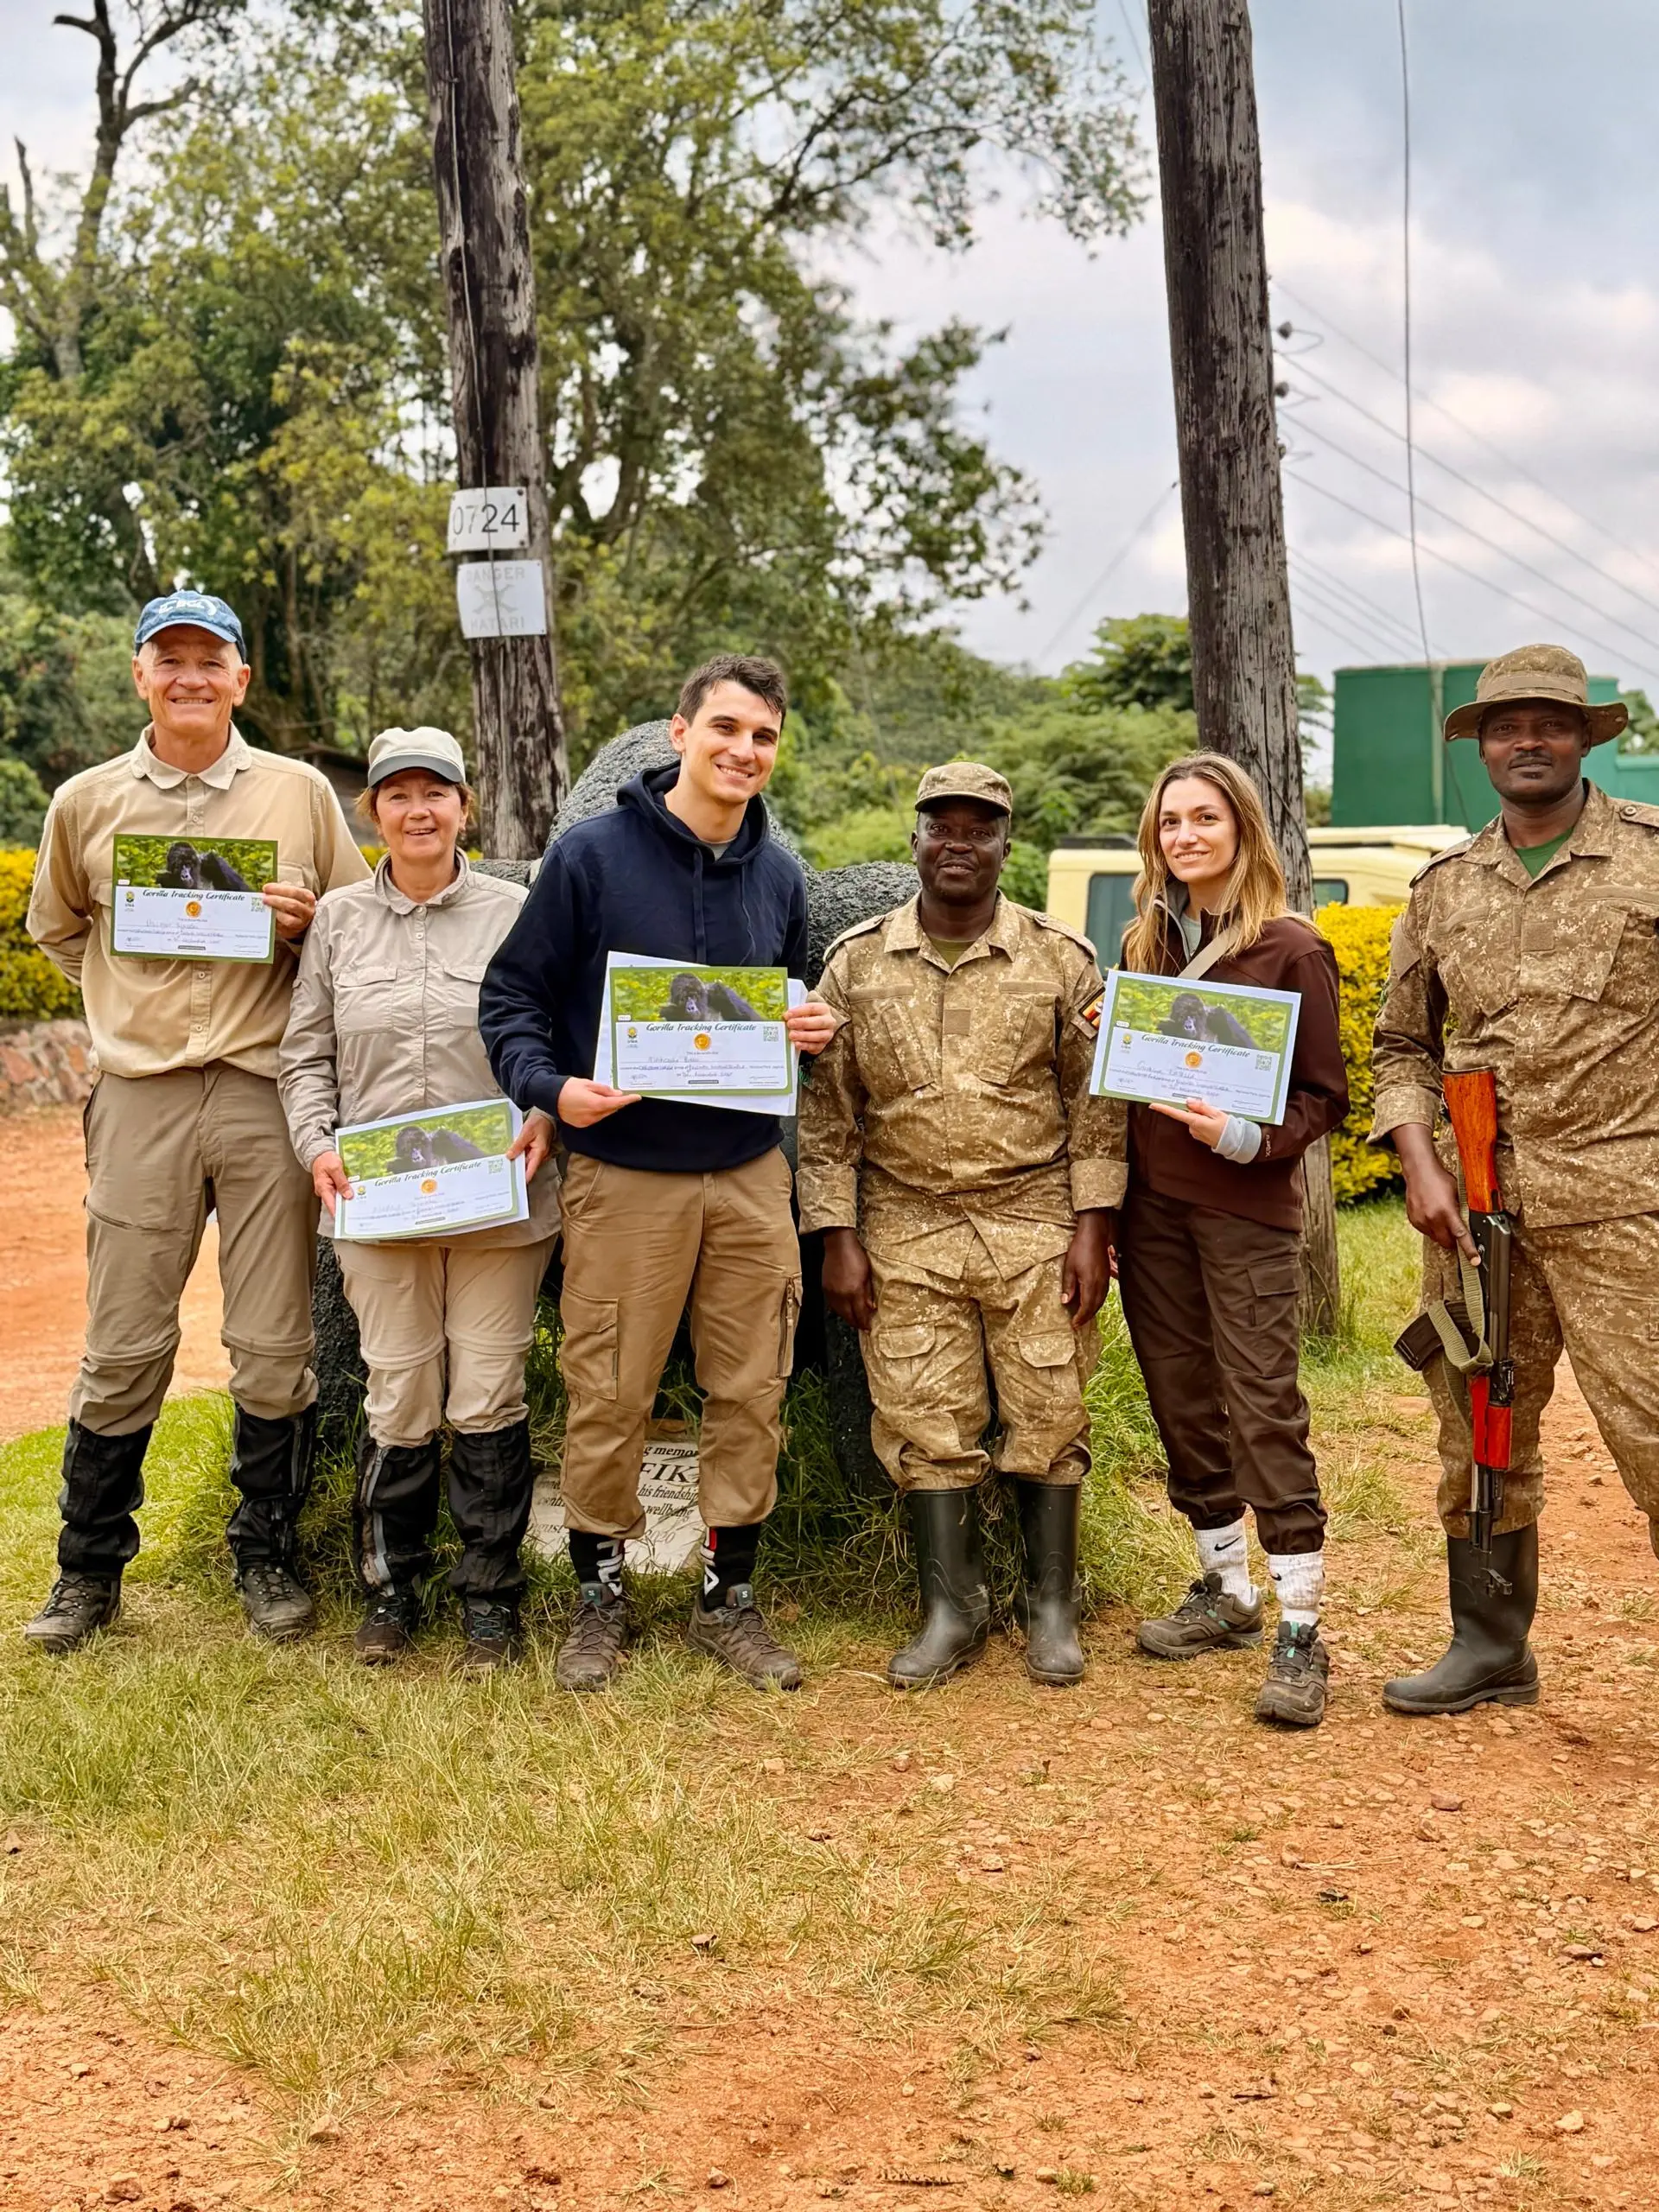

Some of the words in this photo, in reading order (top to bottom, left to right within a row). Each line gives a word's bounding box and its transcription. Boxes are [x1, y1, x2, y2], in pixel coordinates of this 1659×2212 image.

[452, 503, 520, 536] 0724
[466, 567, 526, 582] DANGER
[470, 616, 525, 632] HATARI
[143, 889, 168, 898] Gorilla
[171, 890, 204, 900] Tracking
[206, 892, 245, 901] Certificate
[645, 1023, 674, 1032] Gorilla
[677, 1023, 713, 1033] Tracking
[715, 1023, 757, 1033] Certificate
[1141, 1033, 1169, 1045] Gorilla
[1171, 1039, 1206, 1052] Tracking
[1208, 1044, 1250, 1057] Certificate
[374, 1178, 401, 1187] Gorilla
[404, 1170, 439, 1181] Tracking
[441, 1160, 481, 1174] Certificate
[640, 1462, 699, 1484] FIK
[638, 1484, 653, 1497] his
